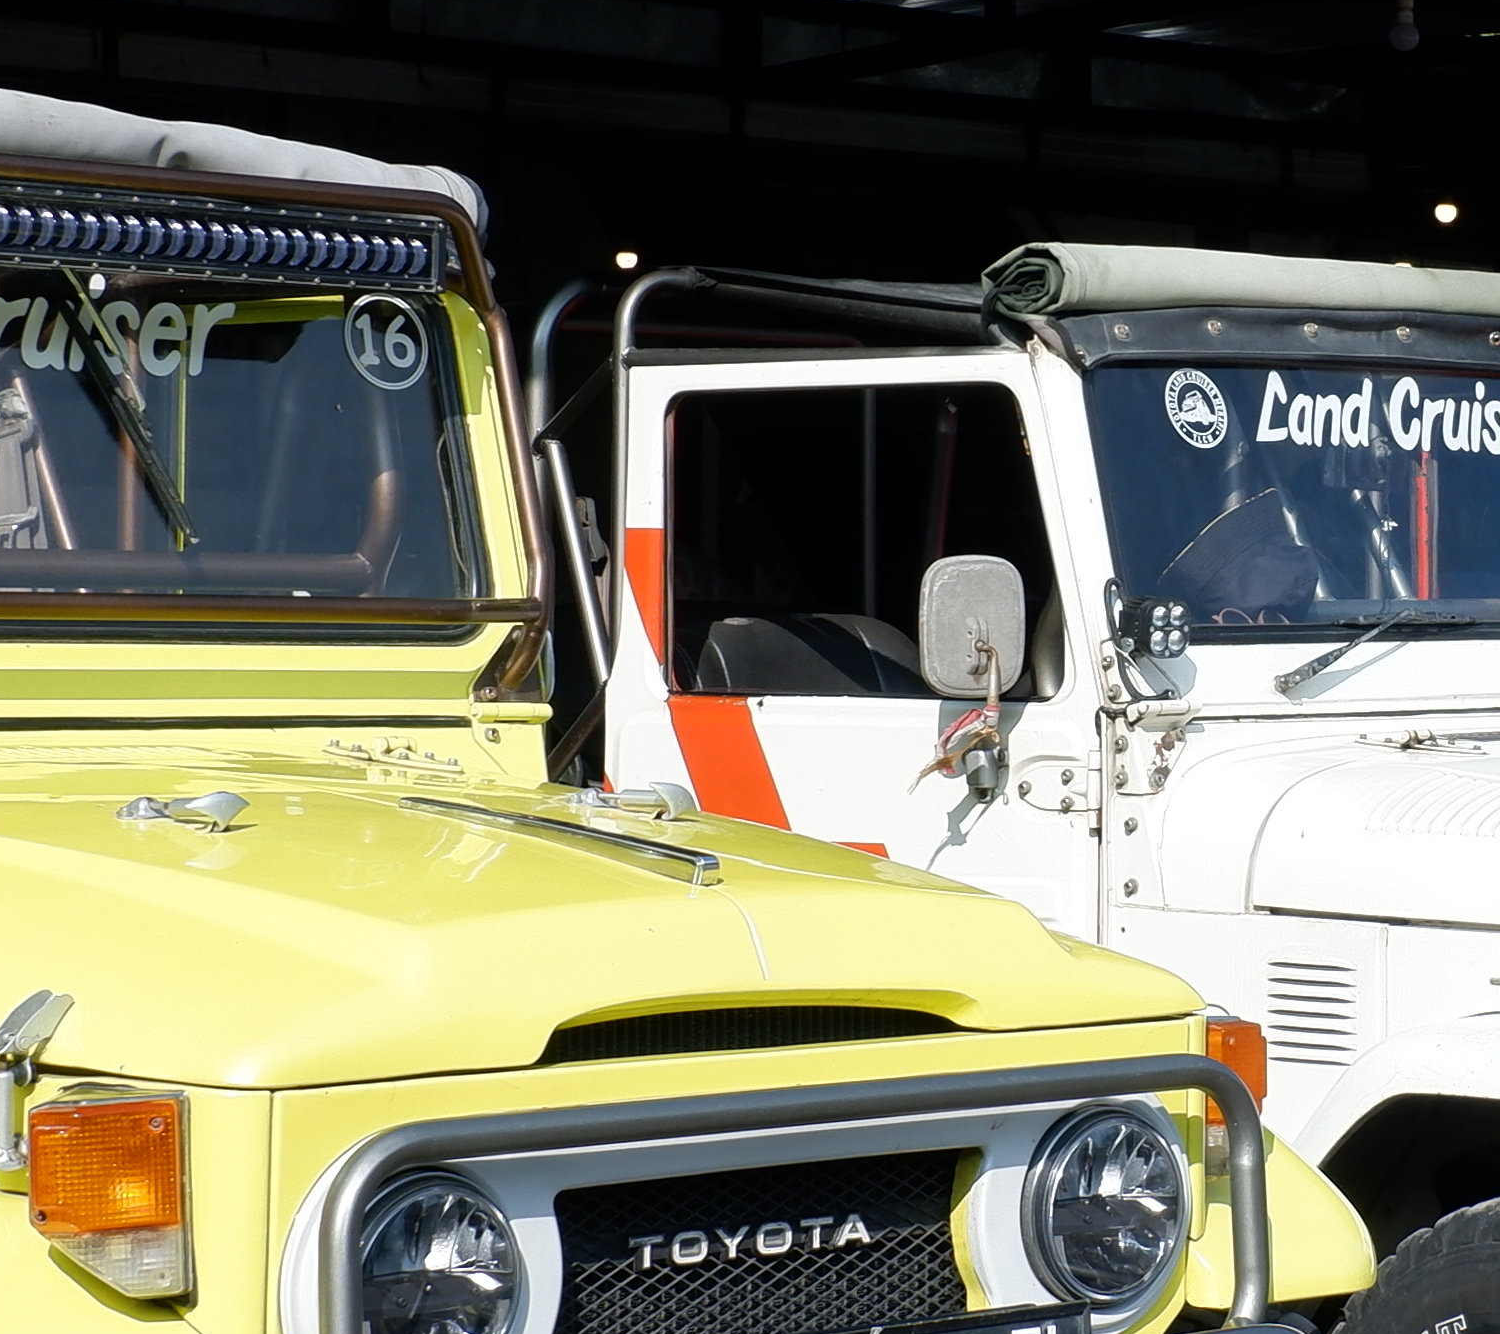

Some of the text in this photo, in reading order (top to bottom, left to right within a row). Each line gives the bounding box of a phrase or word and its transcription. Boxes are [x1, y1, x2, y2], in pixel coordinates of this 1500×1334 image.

[357, 311, 418, 368] 16
[1256, 370, 1371, 448] Land
[629, 1213, 874, 1269] TOYOTA
